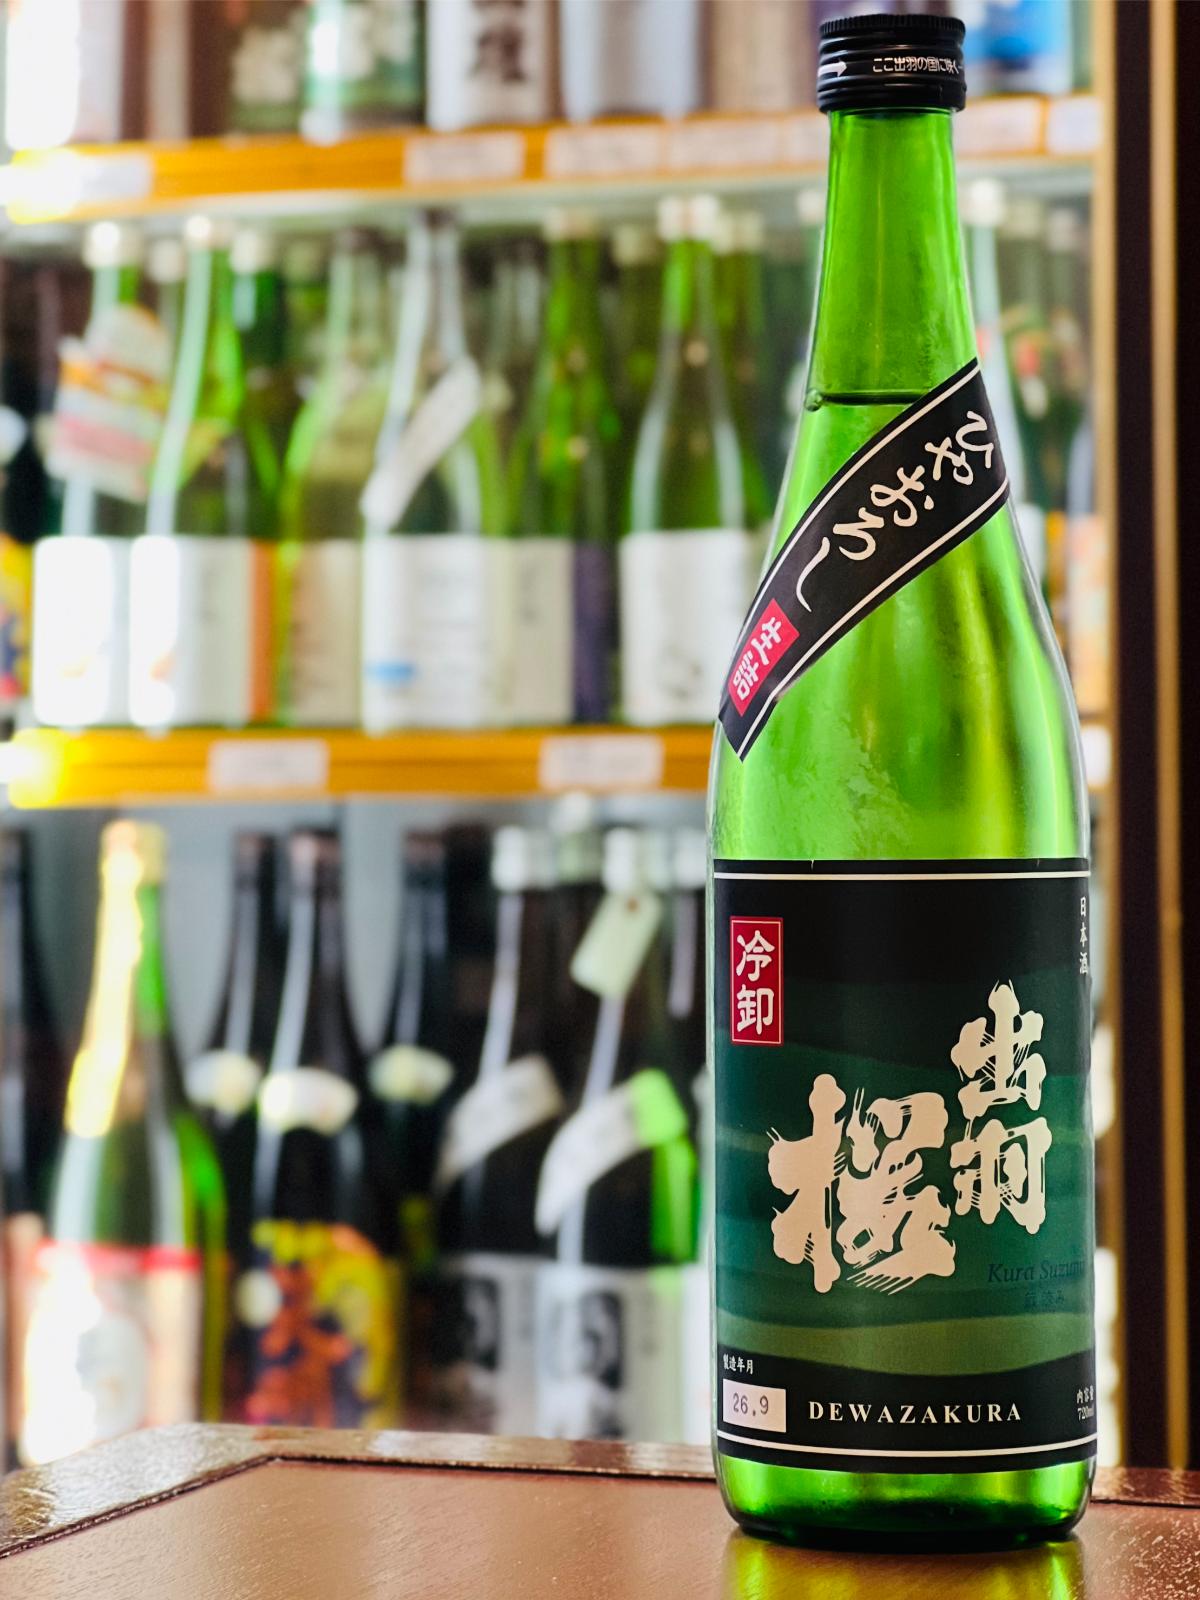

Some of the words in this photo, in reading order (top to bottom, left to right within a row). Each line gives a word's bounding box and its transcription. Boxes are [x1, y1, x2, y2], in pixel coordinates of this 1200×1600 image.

[732, 616, 783, 701] 生詰
[1079, 896, 1089, 975] 日本酒
[735, 929, 776, 1036] 冷卸
[949, 978, 1053, 1235] 出羽
[987, 1263, 1035, 1283] Kura
[723, 1353, 755, 1375] 製造年月
[732, 1392, 769, 1417] 26.9
[808, 1401, 1022, 1425] DEWAZAKURA
